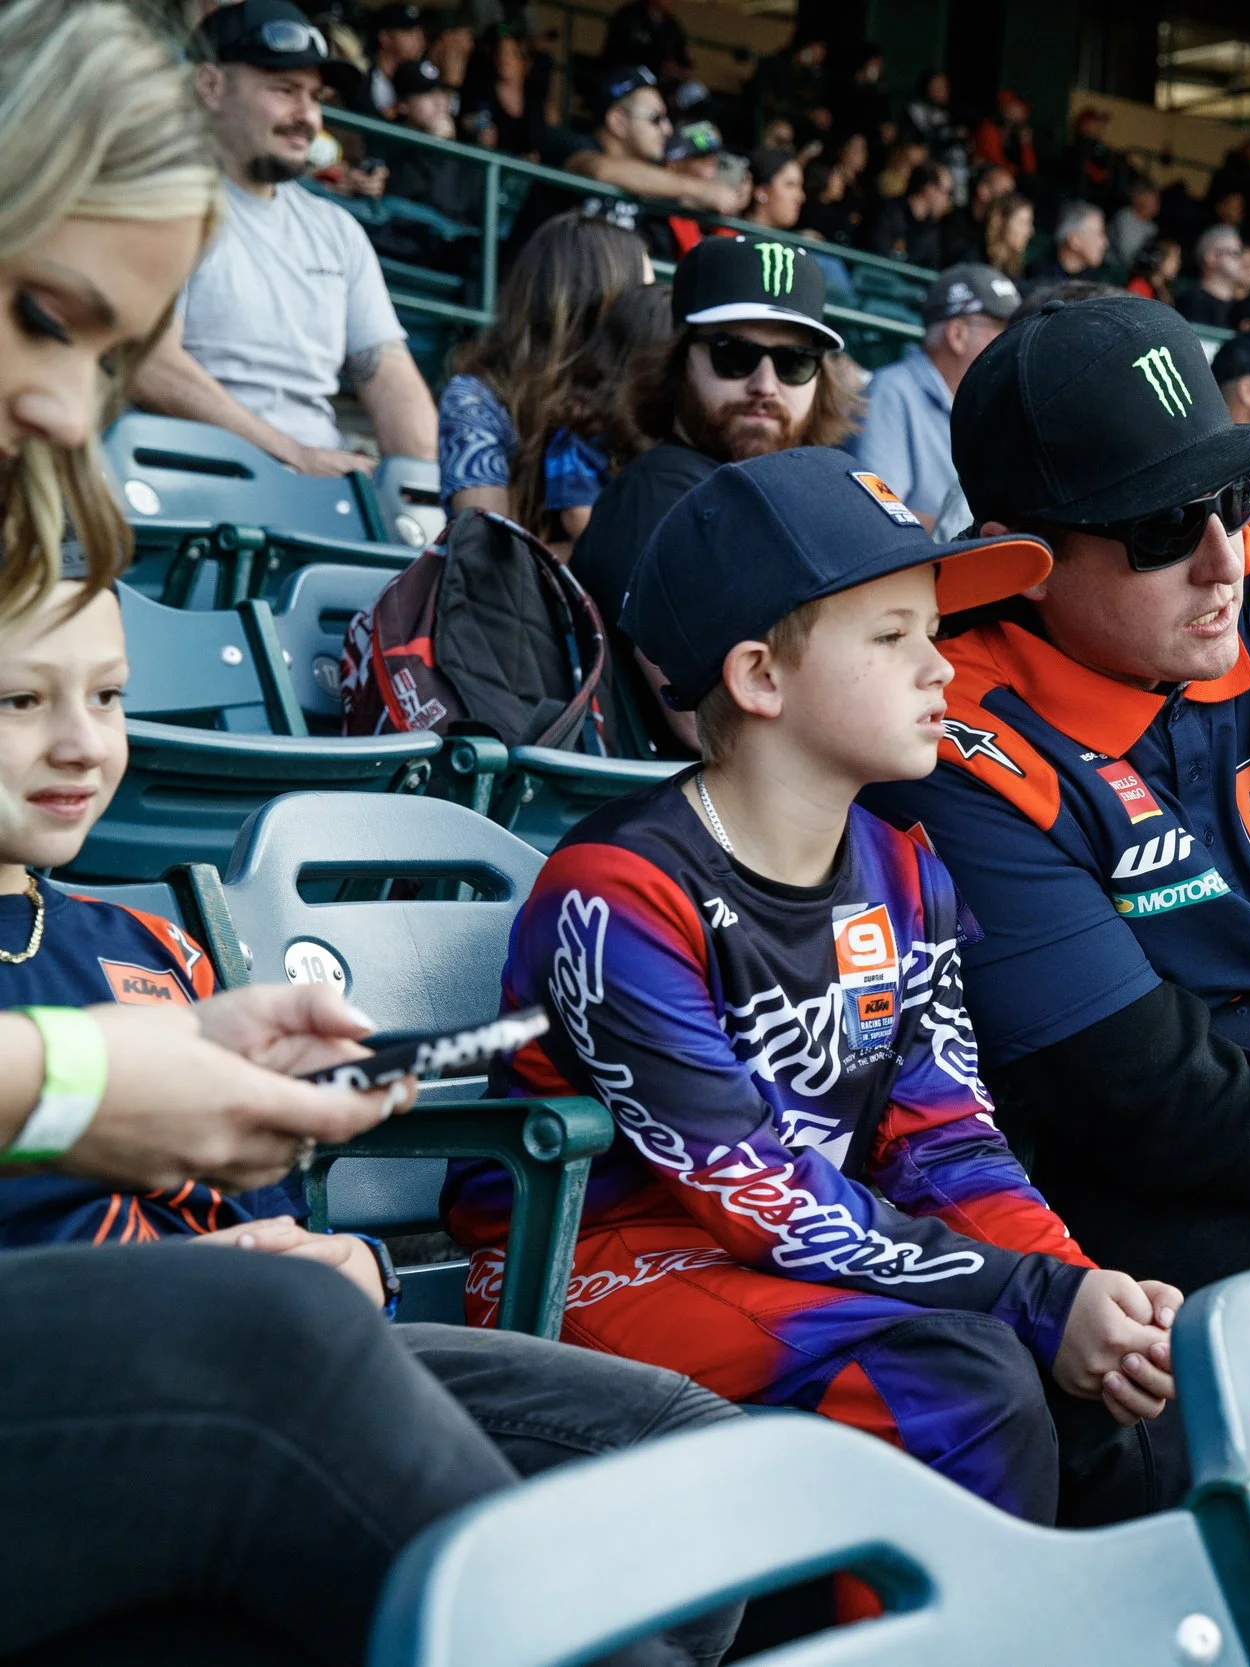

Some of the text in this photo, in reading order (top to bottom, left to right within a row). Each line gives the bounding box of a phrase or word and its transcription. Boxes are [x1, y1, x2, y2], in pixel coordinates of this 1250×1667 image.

[1109, 775, 1138, 790] WELLS
[1120, 787, 1146, 802] FARGO
[1137, 870, 1229, 914] MOTORE
[848, 922, 888, 967] 9
[300, 956, 328, 986] 19
[122, 975, 172, 1001] KTM
[864, 998, 890, 1014] KTM
[860, 1016, 894, 1031] RACING TEAM
